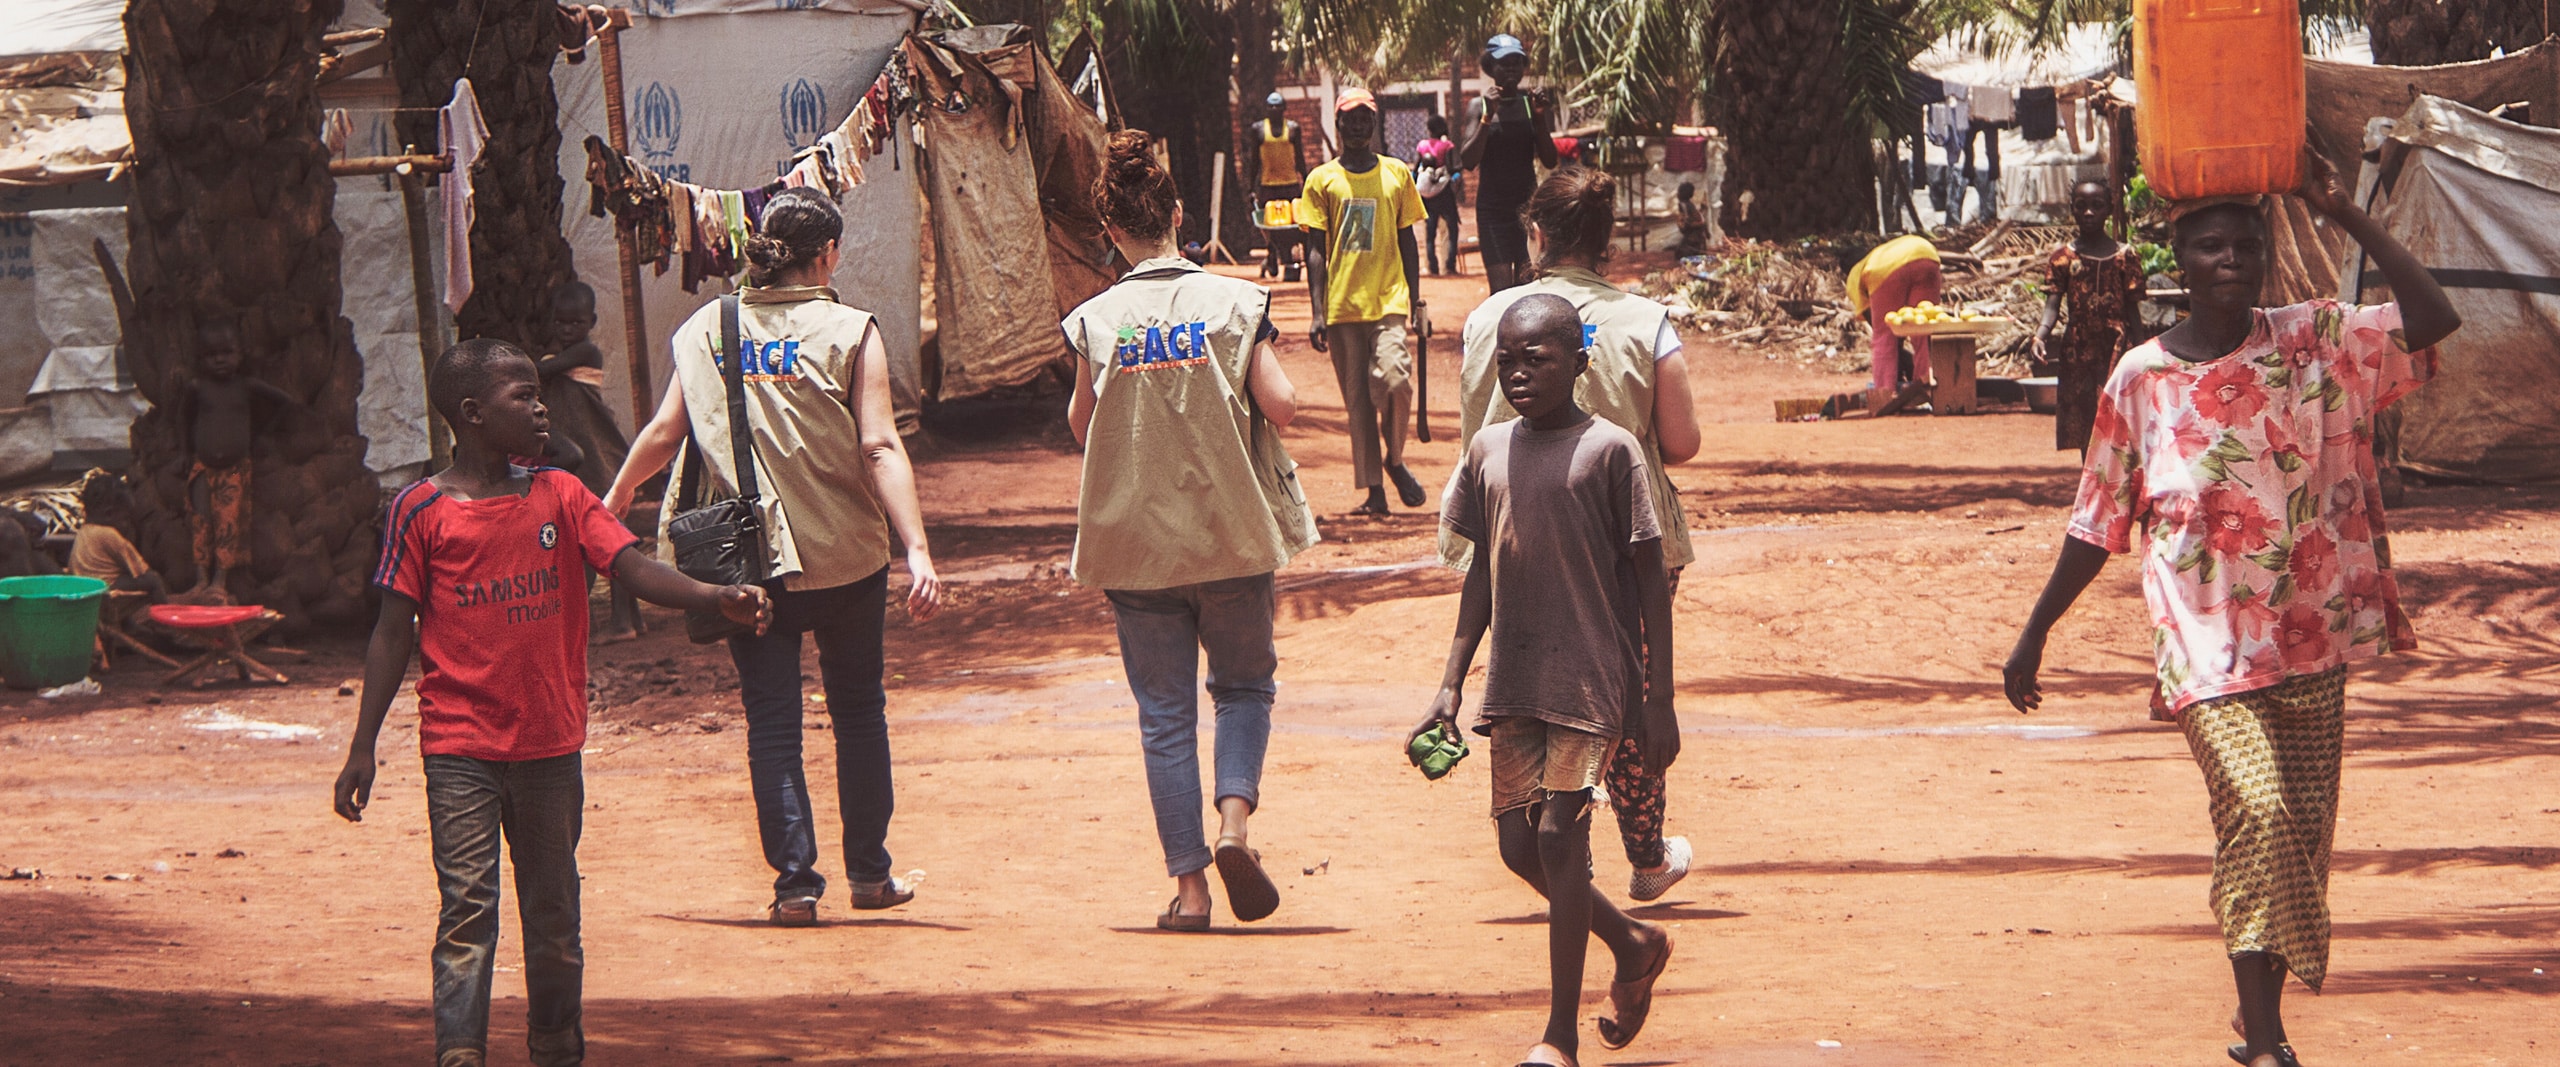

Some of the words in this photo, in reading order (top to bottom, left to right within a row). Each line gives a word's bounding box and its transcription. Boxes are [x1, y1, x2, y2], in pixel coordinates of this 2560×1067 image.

[741, 340, 799, 374] ACF
[1143, 322, 1205, 363] ACF
[455, 565, 559, 607] SAMSUNG
[507, 596, 561, 625] mobile
